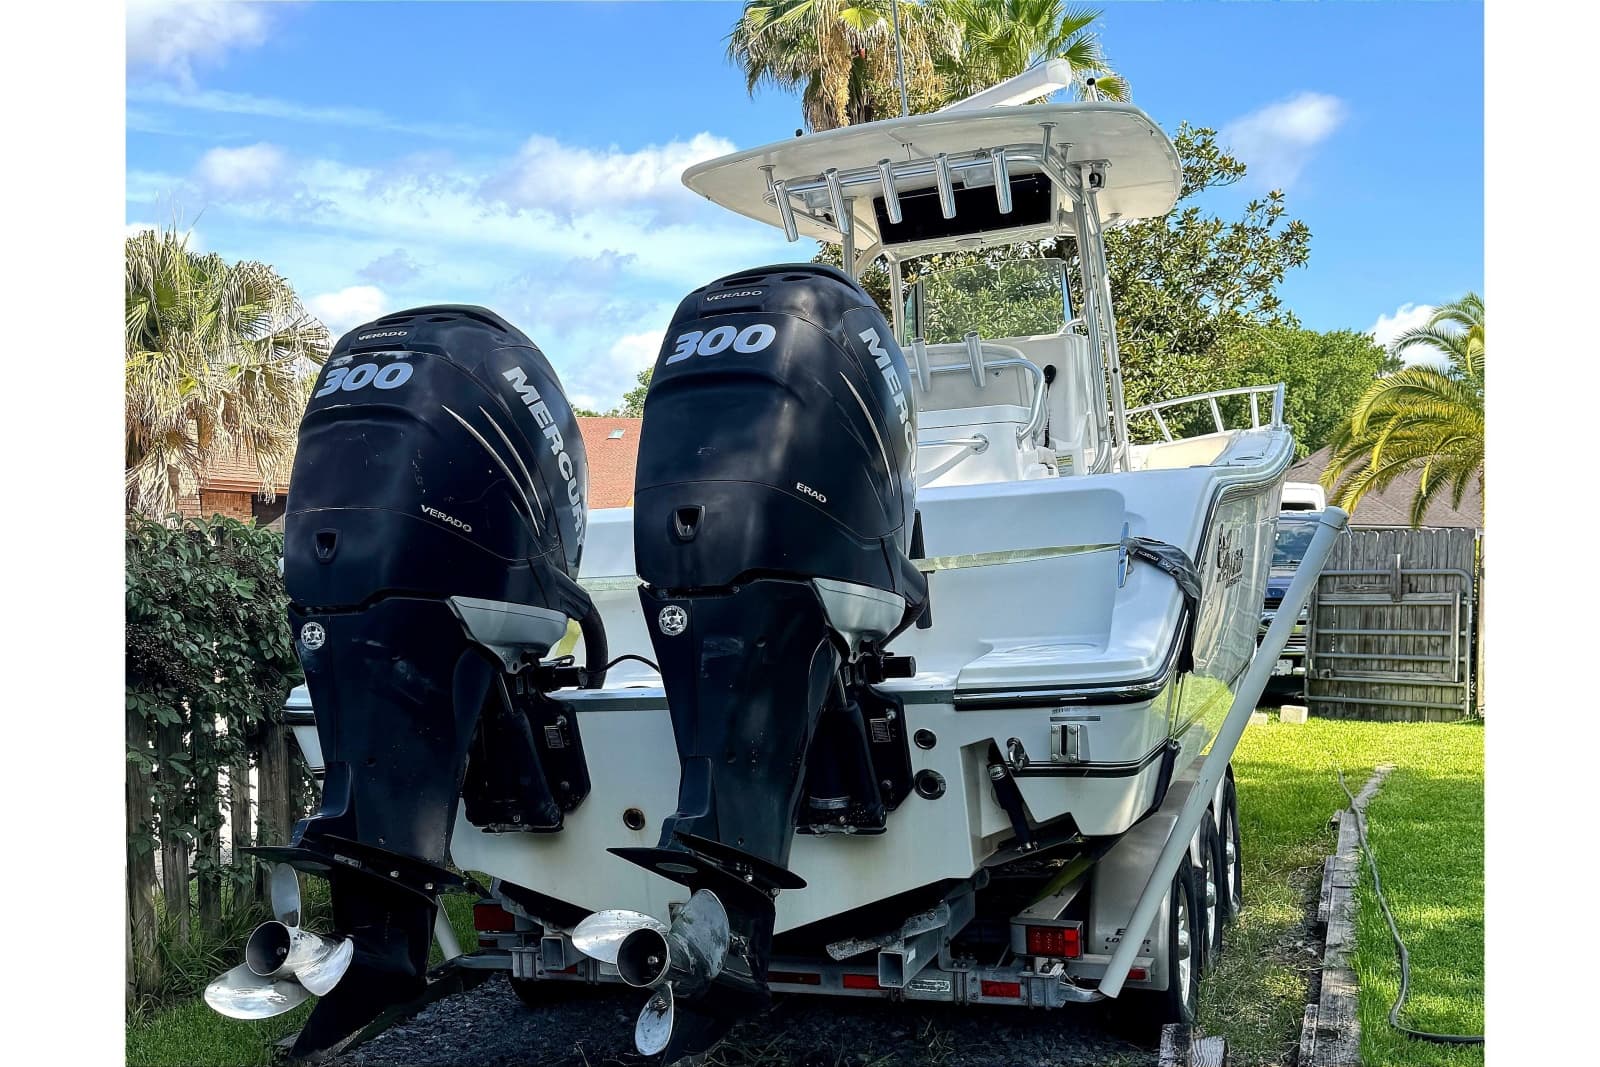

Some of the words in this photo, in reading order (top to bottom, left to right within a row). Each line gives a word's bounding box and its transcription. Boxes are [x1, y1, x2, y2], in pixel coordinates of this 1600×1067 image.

[706, 290, 763, 302] VERADO
[358, 331, 408, 341] VERADO
[665, 324, 777, 366] 300
[314, 362, 414, 399] 300
[421, 504, 473, 532] VERADO
